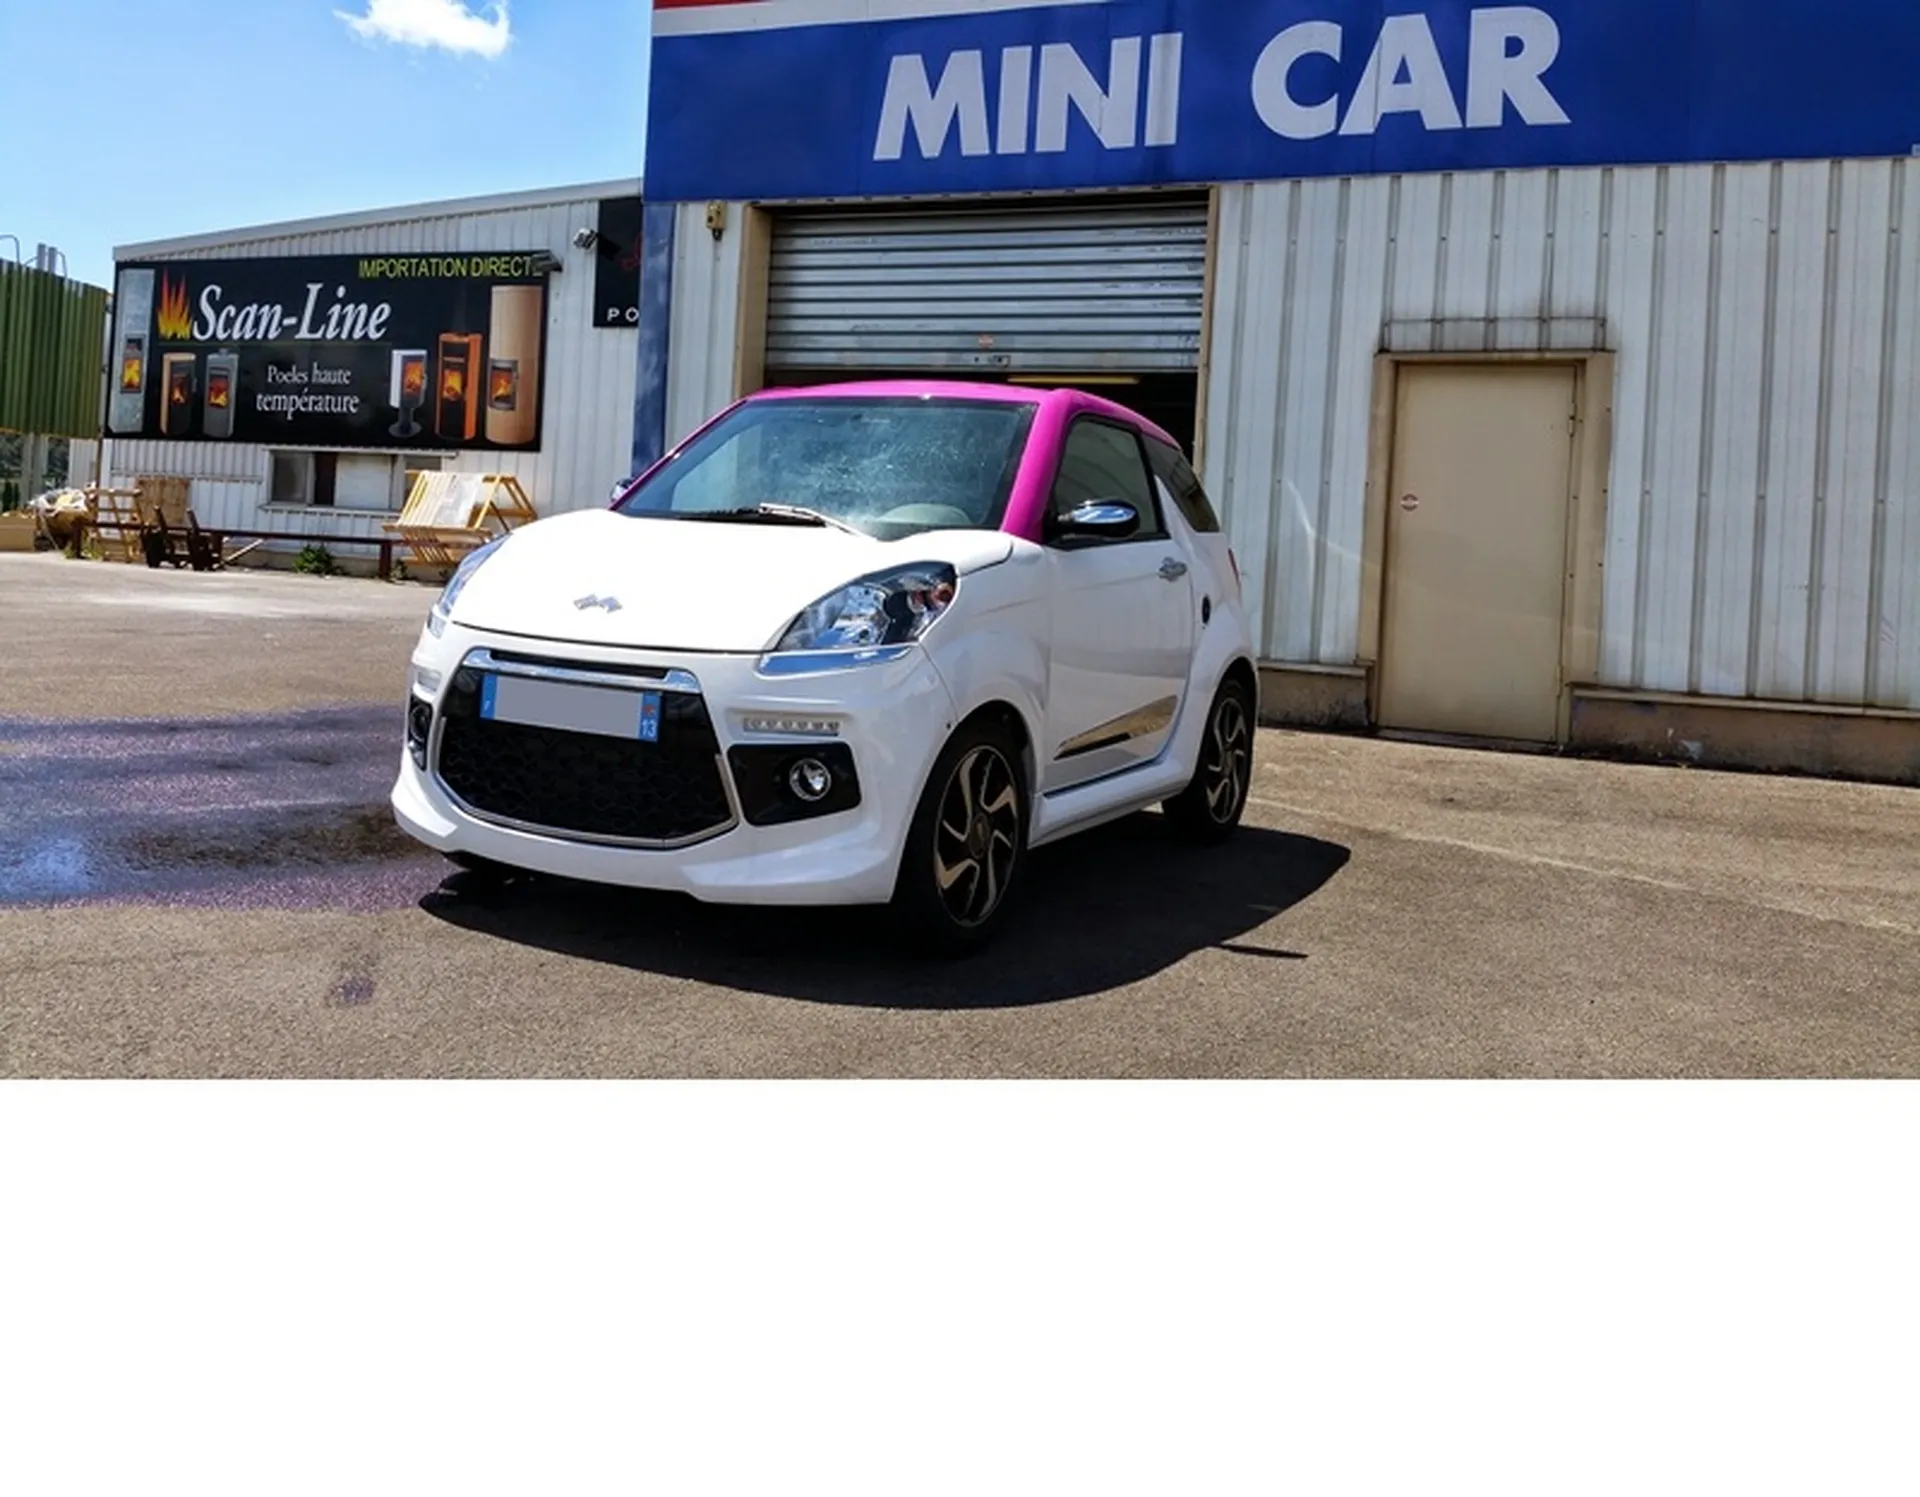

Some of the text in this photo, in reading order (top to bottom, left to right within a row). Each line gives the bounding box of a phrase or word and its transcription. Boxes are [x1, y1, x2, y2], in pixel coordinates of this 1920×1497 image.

[873, 5, 1572, 162] MINI CAR
[358, 256, 544, 278] IMPORTATION DIRECT
[193, 282, 392, 341] Scan-Line
[311, 361, 352, 384] haute
[256, 387, 360, 420] température
[640, 719, 657, 737] 13
